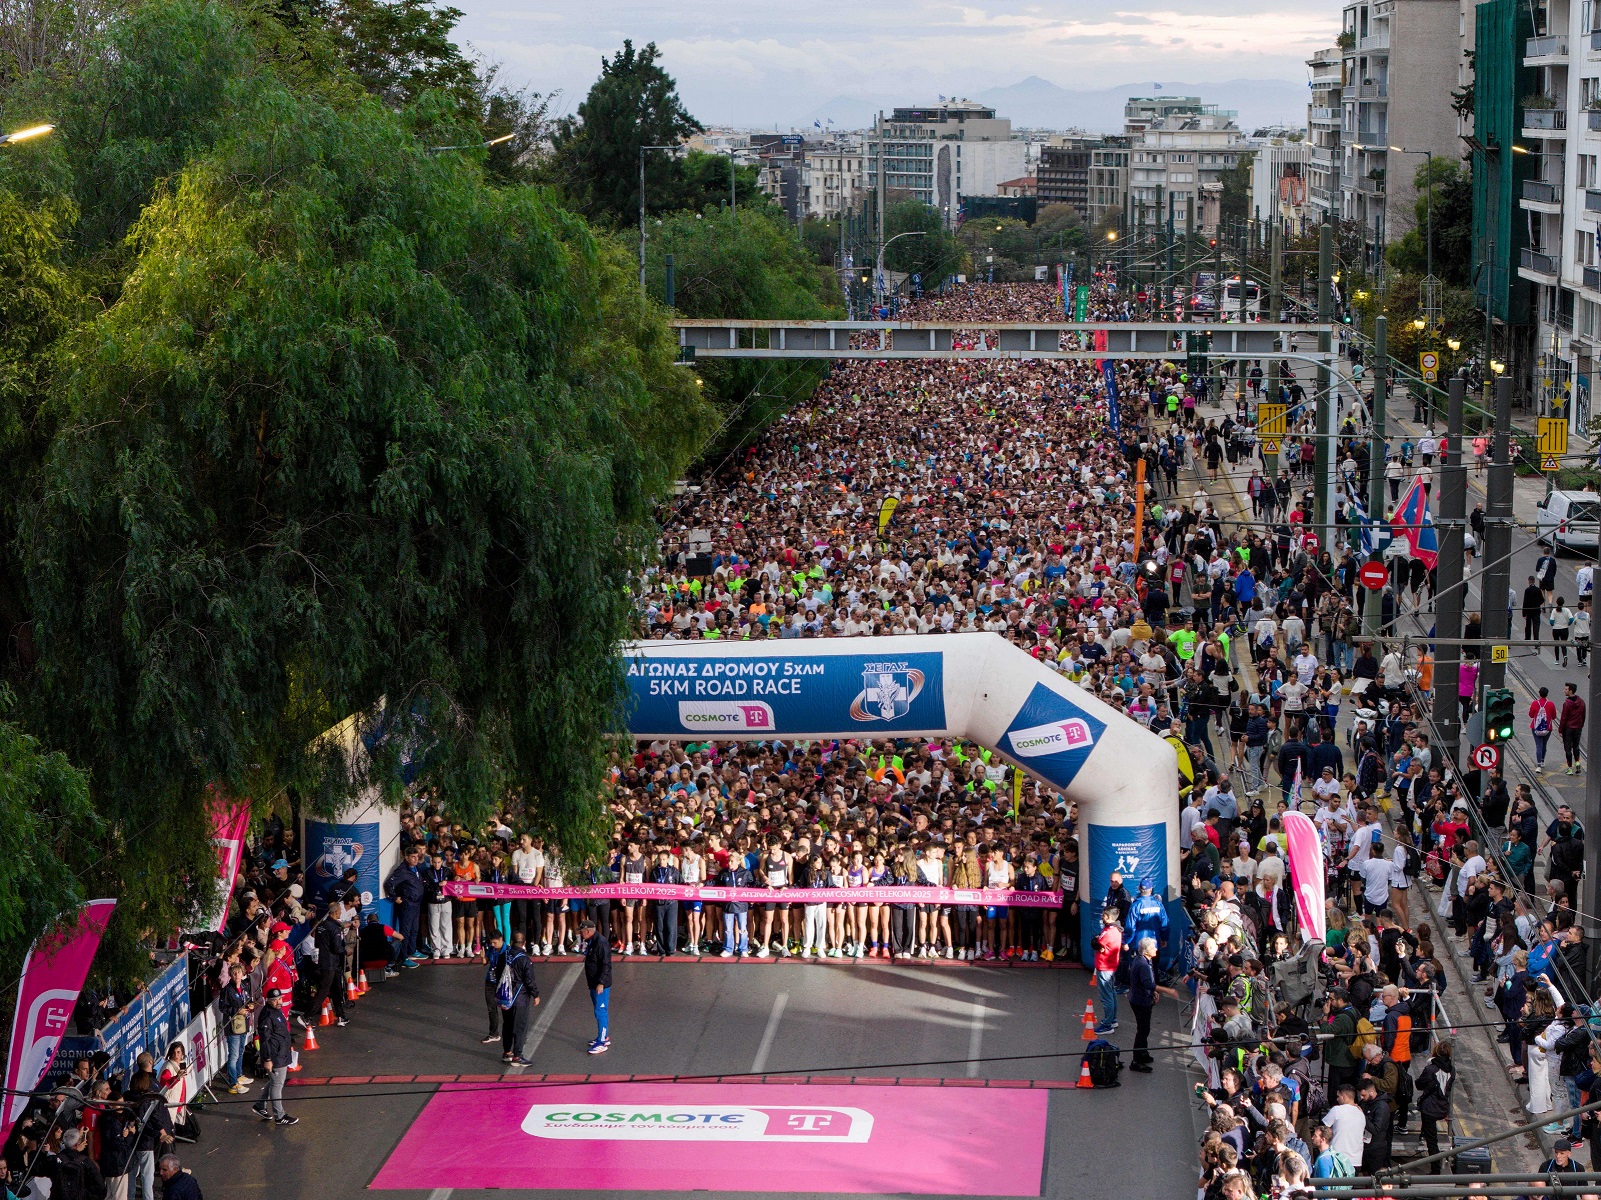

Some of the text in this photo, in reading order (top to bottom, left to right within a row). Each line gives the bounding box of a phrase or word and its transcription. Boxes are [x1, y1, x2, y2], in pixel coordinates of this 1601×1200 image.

[1496, 650, 1504, 659] 50
[627, 663, 697, 676] ΑΓΩΝΑΣ
[702, 663, 779, 676] ΔΡΟΜΟΥ
[864, 662, 908, 672] ΣΕΓΑΣ
[650, 678, 801, 696] 5KM ROAD RACE
[913, 890, 931, 898] 2025
[1041, 895, 1063, 904] RACE
[545, 1112, 832, 1130] COSMOTE T
